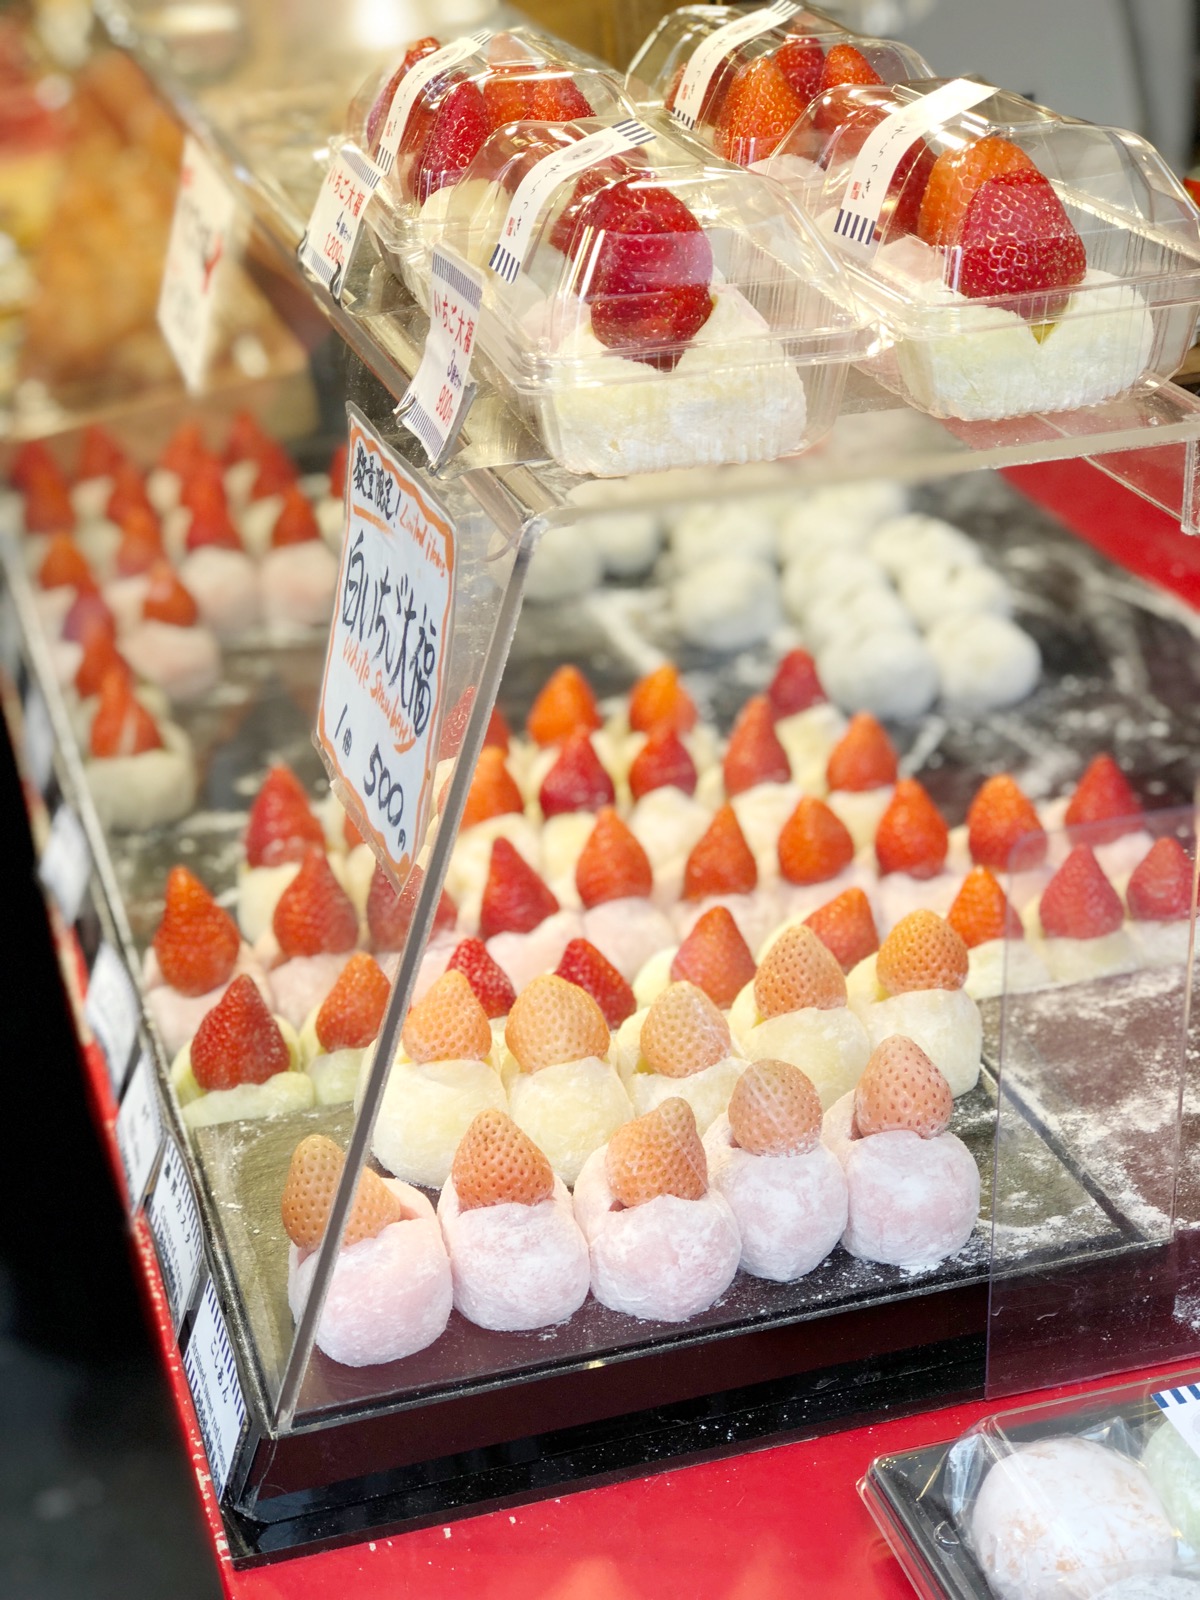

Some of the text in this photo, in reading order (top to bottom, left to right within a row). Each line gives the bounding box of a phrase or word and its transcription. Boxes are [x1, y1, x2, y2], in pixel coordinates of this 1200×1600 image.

[328, 166, 365, 218] いちご大福
[434, 290, 475, 355] いちご大福
[343, 529, 437, 738] 白いちご大福
[342, 635, 417, 754] White Strawberry
[210, 1336, 229, 1404] こしあん
